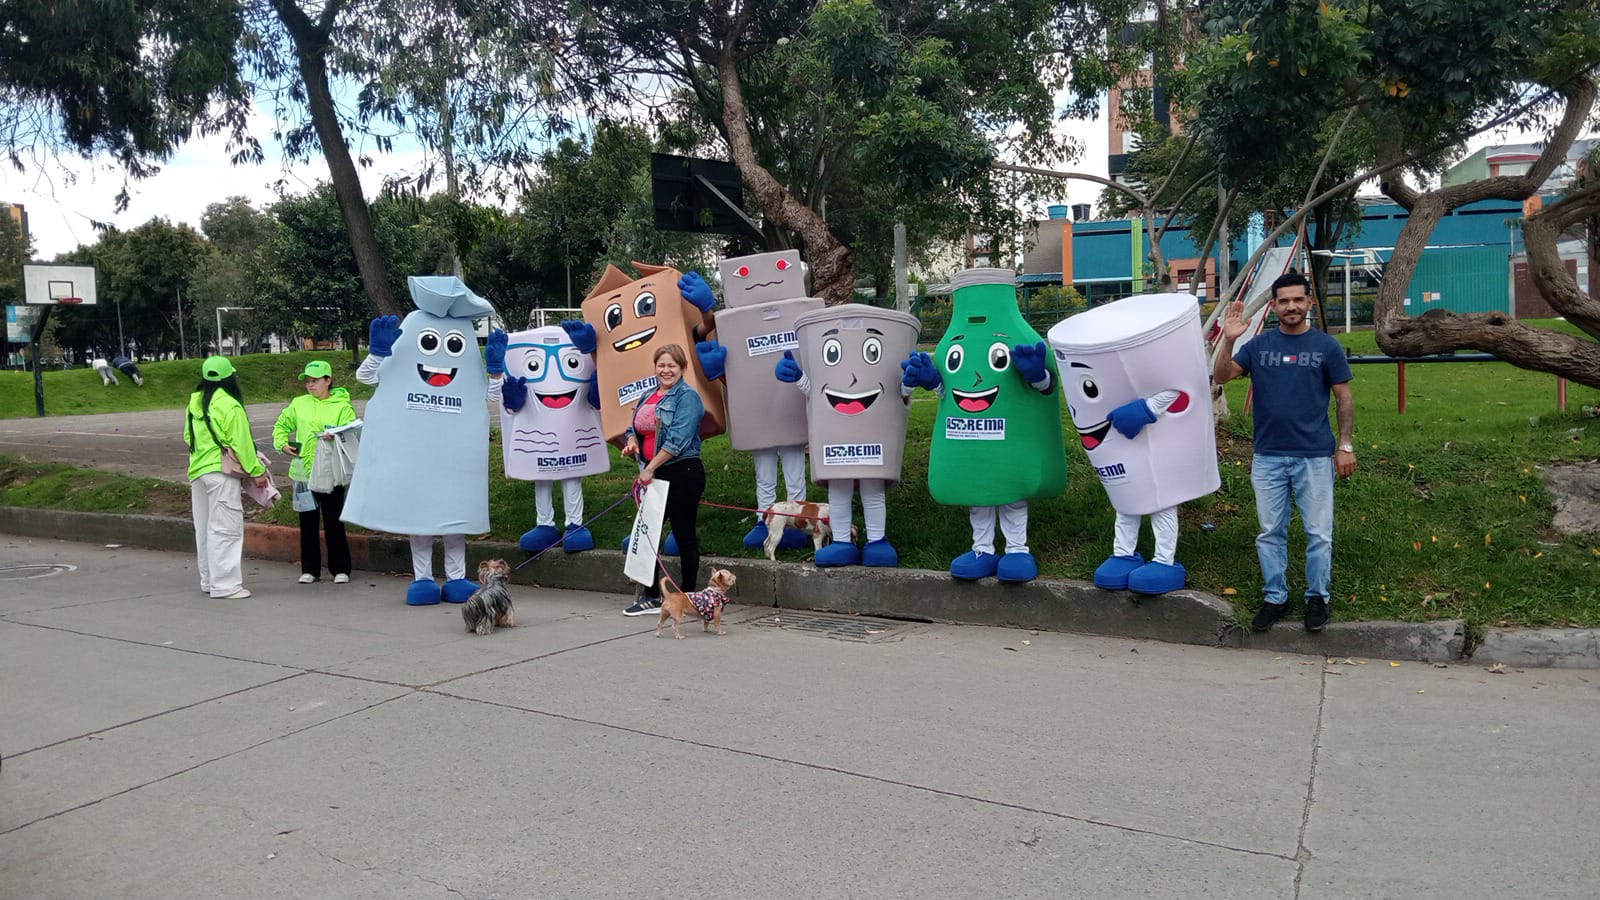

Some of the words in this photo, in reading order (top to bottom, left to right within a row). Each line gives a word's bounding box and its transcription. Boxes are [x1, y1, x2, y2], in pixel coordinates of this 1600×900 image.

[747, 332, 798, 349] ASOREM
[1259, 350, 1281, 367] TH
[1297, 351, 1323, 369] 85
[618, 376, 660, 398] ASOREM
